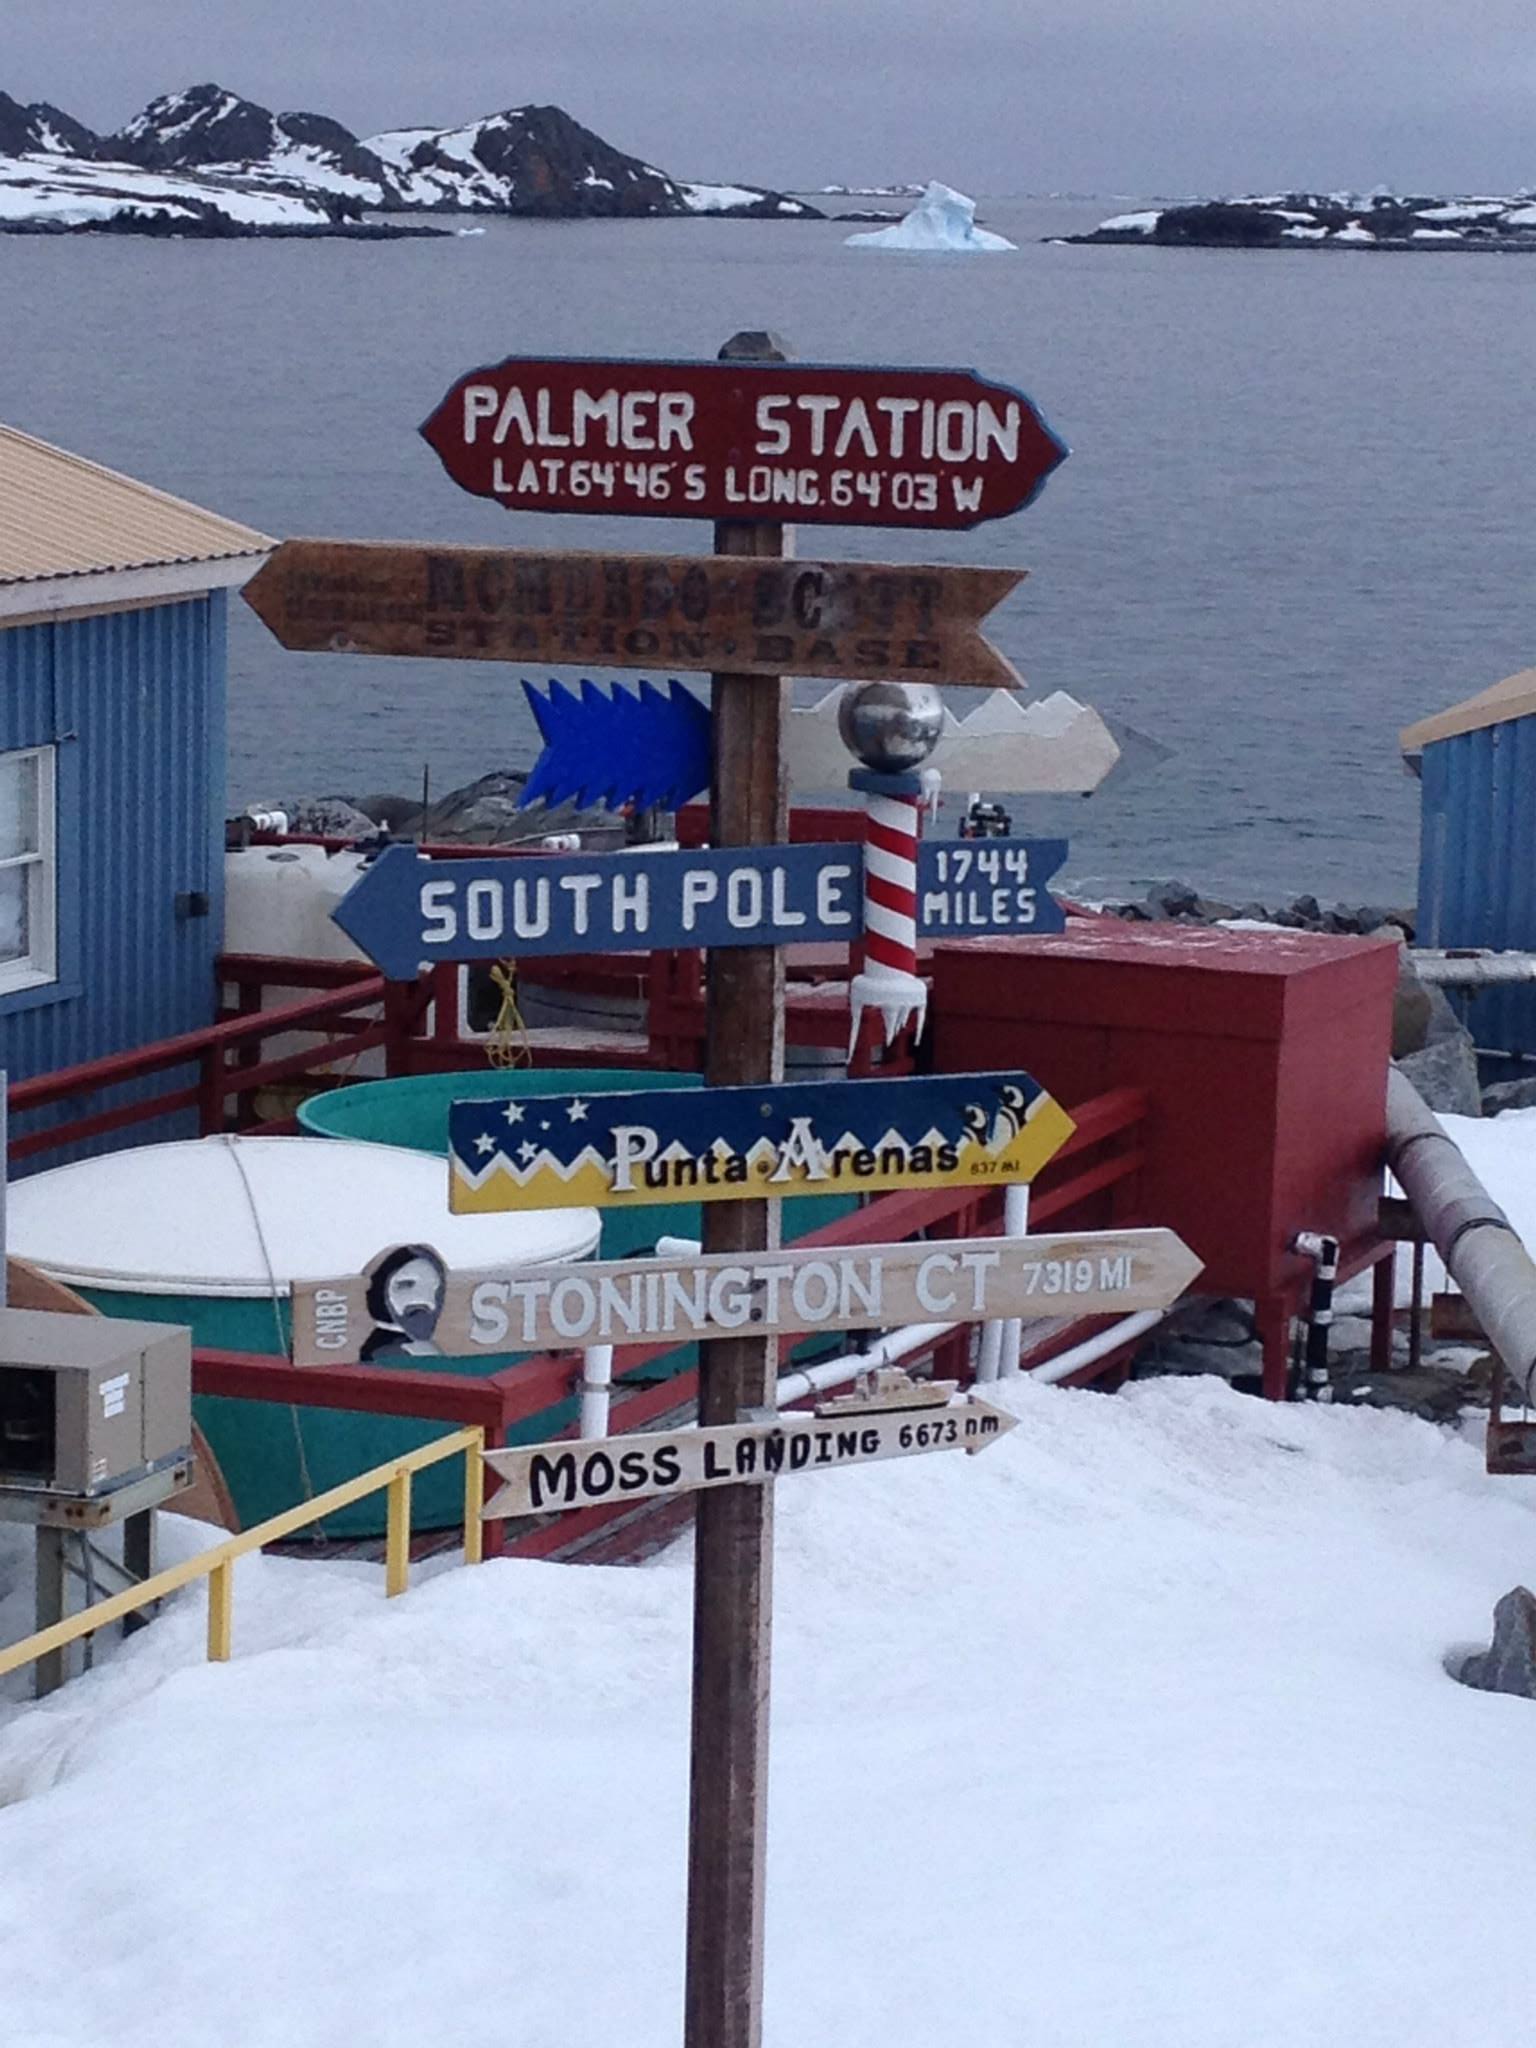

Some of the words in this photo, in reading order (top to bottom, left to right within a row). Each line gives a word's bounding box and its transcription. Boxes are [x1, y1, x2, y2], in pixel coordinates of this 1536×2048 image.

[464, 384, 695, 450] PALMER
[755, 394, 1020, 463] STATION
[952, 475, 984, 512] W
[753, 634, 941, 669] BASE
[935, 848, 1029, 885] 1744
[420, 874, 652, 943] SOUTH
[682, 864, 853, 931] POLE
[922, 886, 1037, 926] MILES
[609, 1124, 749, 1193] Punta
[768, 1115, 960, 1183] Arenas
[469, 1256, 883, 1345] STONINGTON
[916, 1251, 1000, 1313] CT
[1023, 1258, 1094, 1295] 7319
[1099, 1255, 1132, 1292] MI
[314, 1288, 348, 1349] CNBP
[898, 1421, 959, 1450] 6673
[964, 1413, 1000, 1438] nm
[528, 1444, 682, 1508] MOSS
[703, 1427, 882, 1480] LANDING
